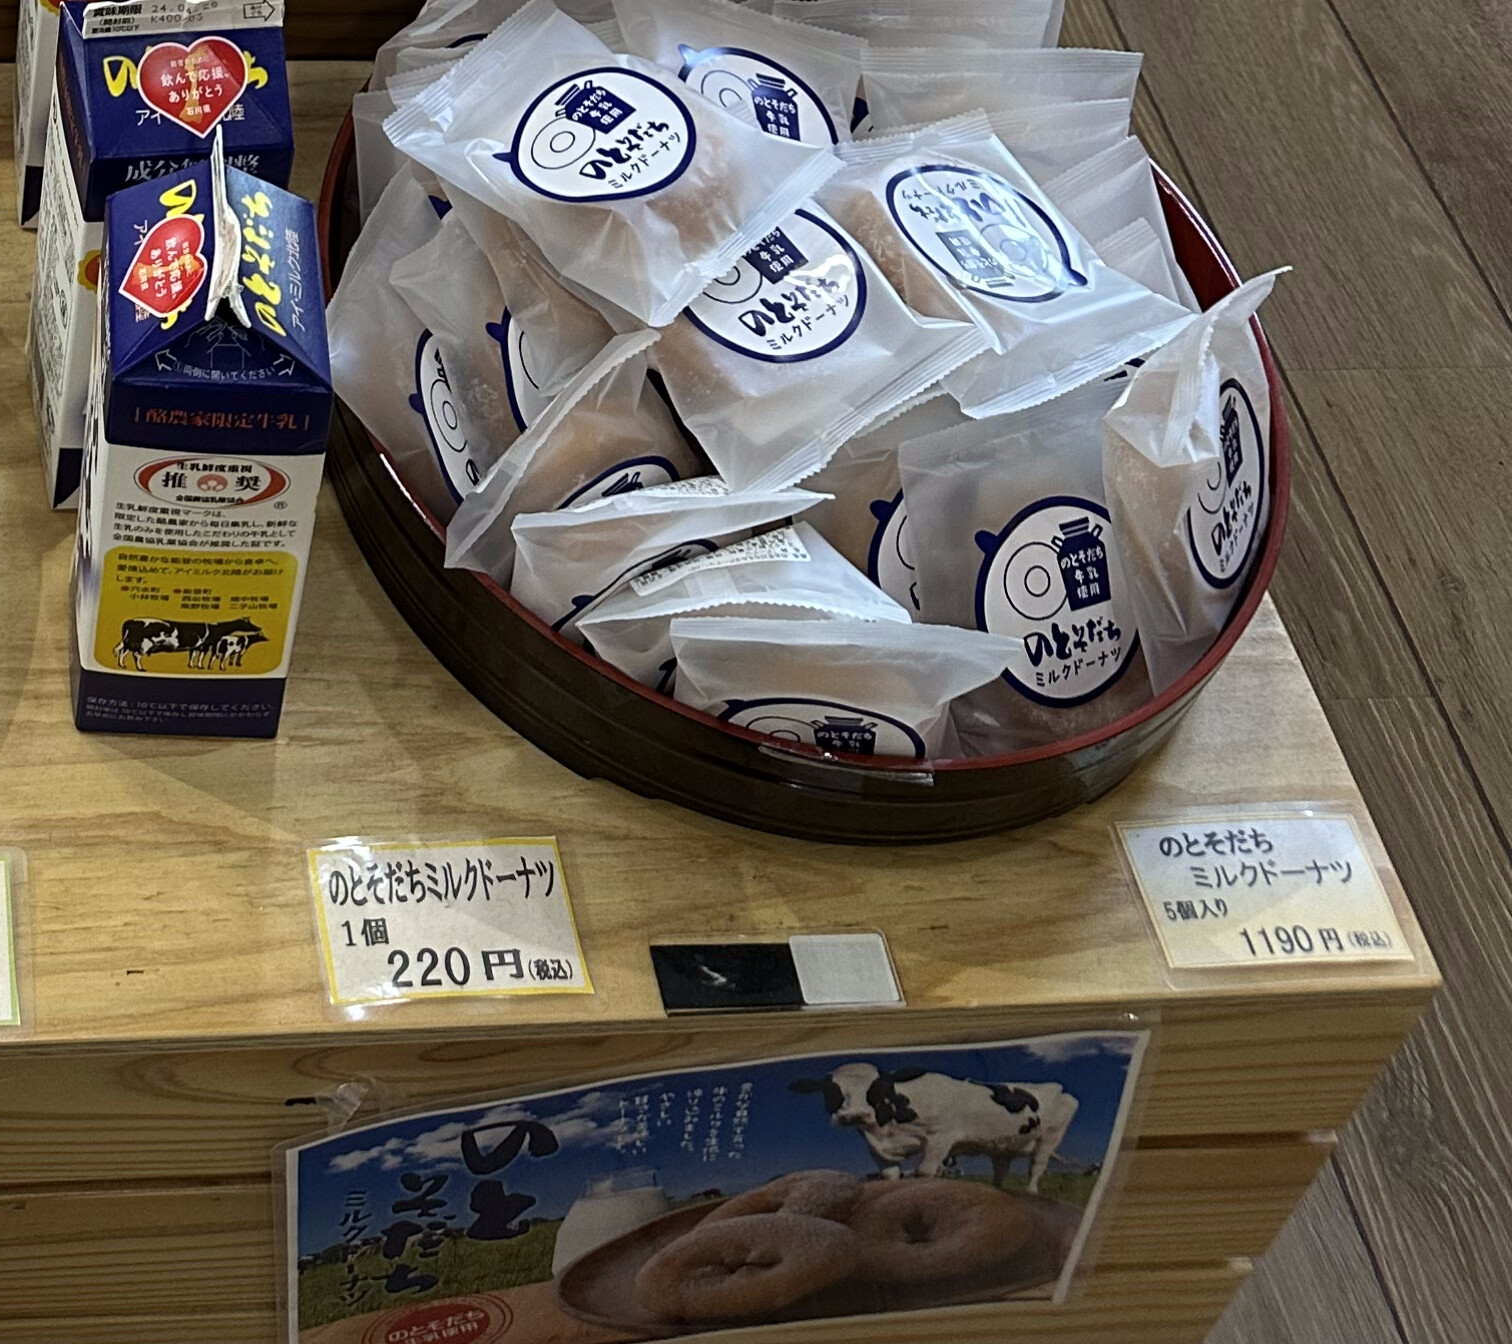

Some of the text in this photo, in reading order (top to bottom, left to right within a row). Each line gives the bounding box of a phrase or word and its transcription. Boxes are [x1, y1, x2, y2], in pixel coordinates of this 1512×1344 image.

[159, 67, 231, 89] 飲んで応援、
[168, 85, 223, 104] ありがとう
[186, 104, 212, 116] 石川県
[589, 100, 613, 119] 牛乳
[766, 110, 790, 126] 牛乳
[1074, 567, 1099, 583] 牛乳
[1076, 584, 1101, 600] 使用
[1159, 827, 1274, 858] のとそだち
[328, 855, 555, 907] のとそだちミルクドーナツ
[1190, 858, 1354, 890] ミルクドーナツ
[1163, 897, 1229, 923] 5個入り
[340, 916, 390, 947] 1個
[460, 1117, 559, 1242] のと
